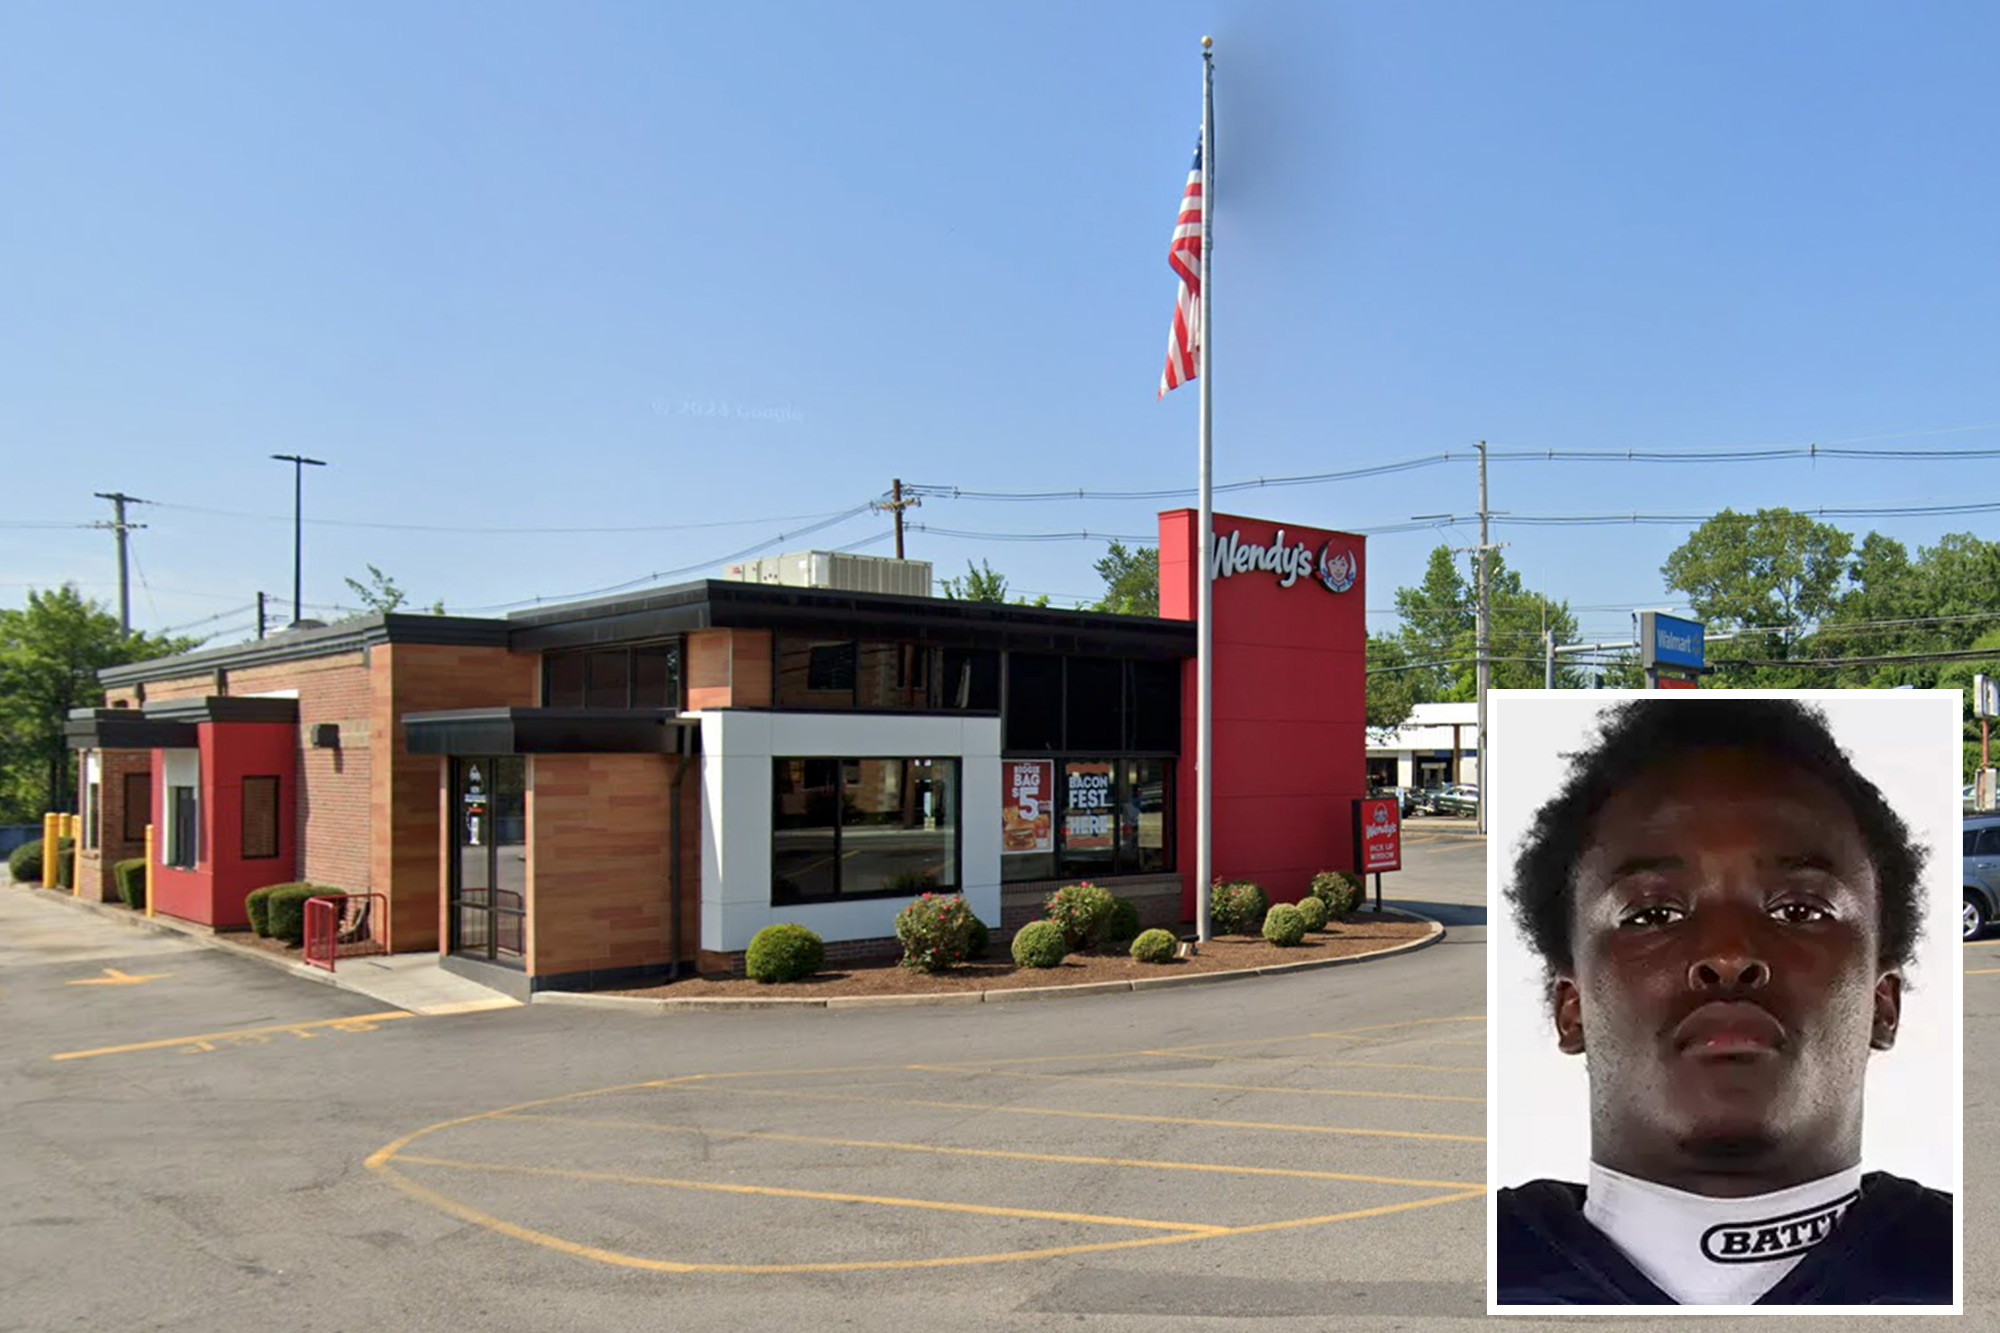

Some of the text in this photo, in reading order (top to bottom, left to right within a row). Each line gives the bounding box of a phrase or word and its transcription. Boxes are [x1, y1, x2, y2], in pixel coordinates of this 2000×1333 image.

[1212, 529, 1312, 587] Wendy's
[1657, 629, 1691, 653] Walmart
[1014, 773, 1040, 787] BAG
[1069, 776, 1108, 789] BACON
[1069, 789, 1108, 808] FEST
[1069, 815, 1108, 835] HERE
[1366, 821, 1396, 840] Wendy's
